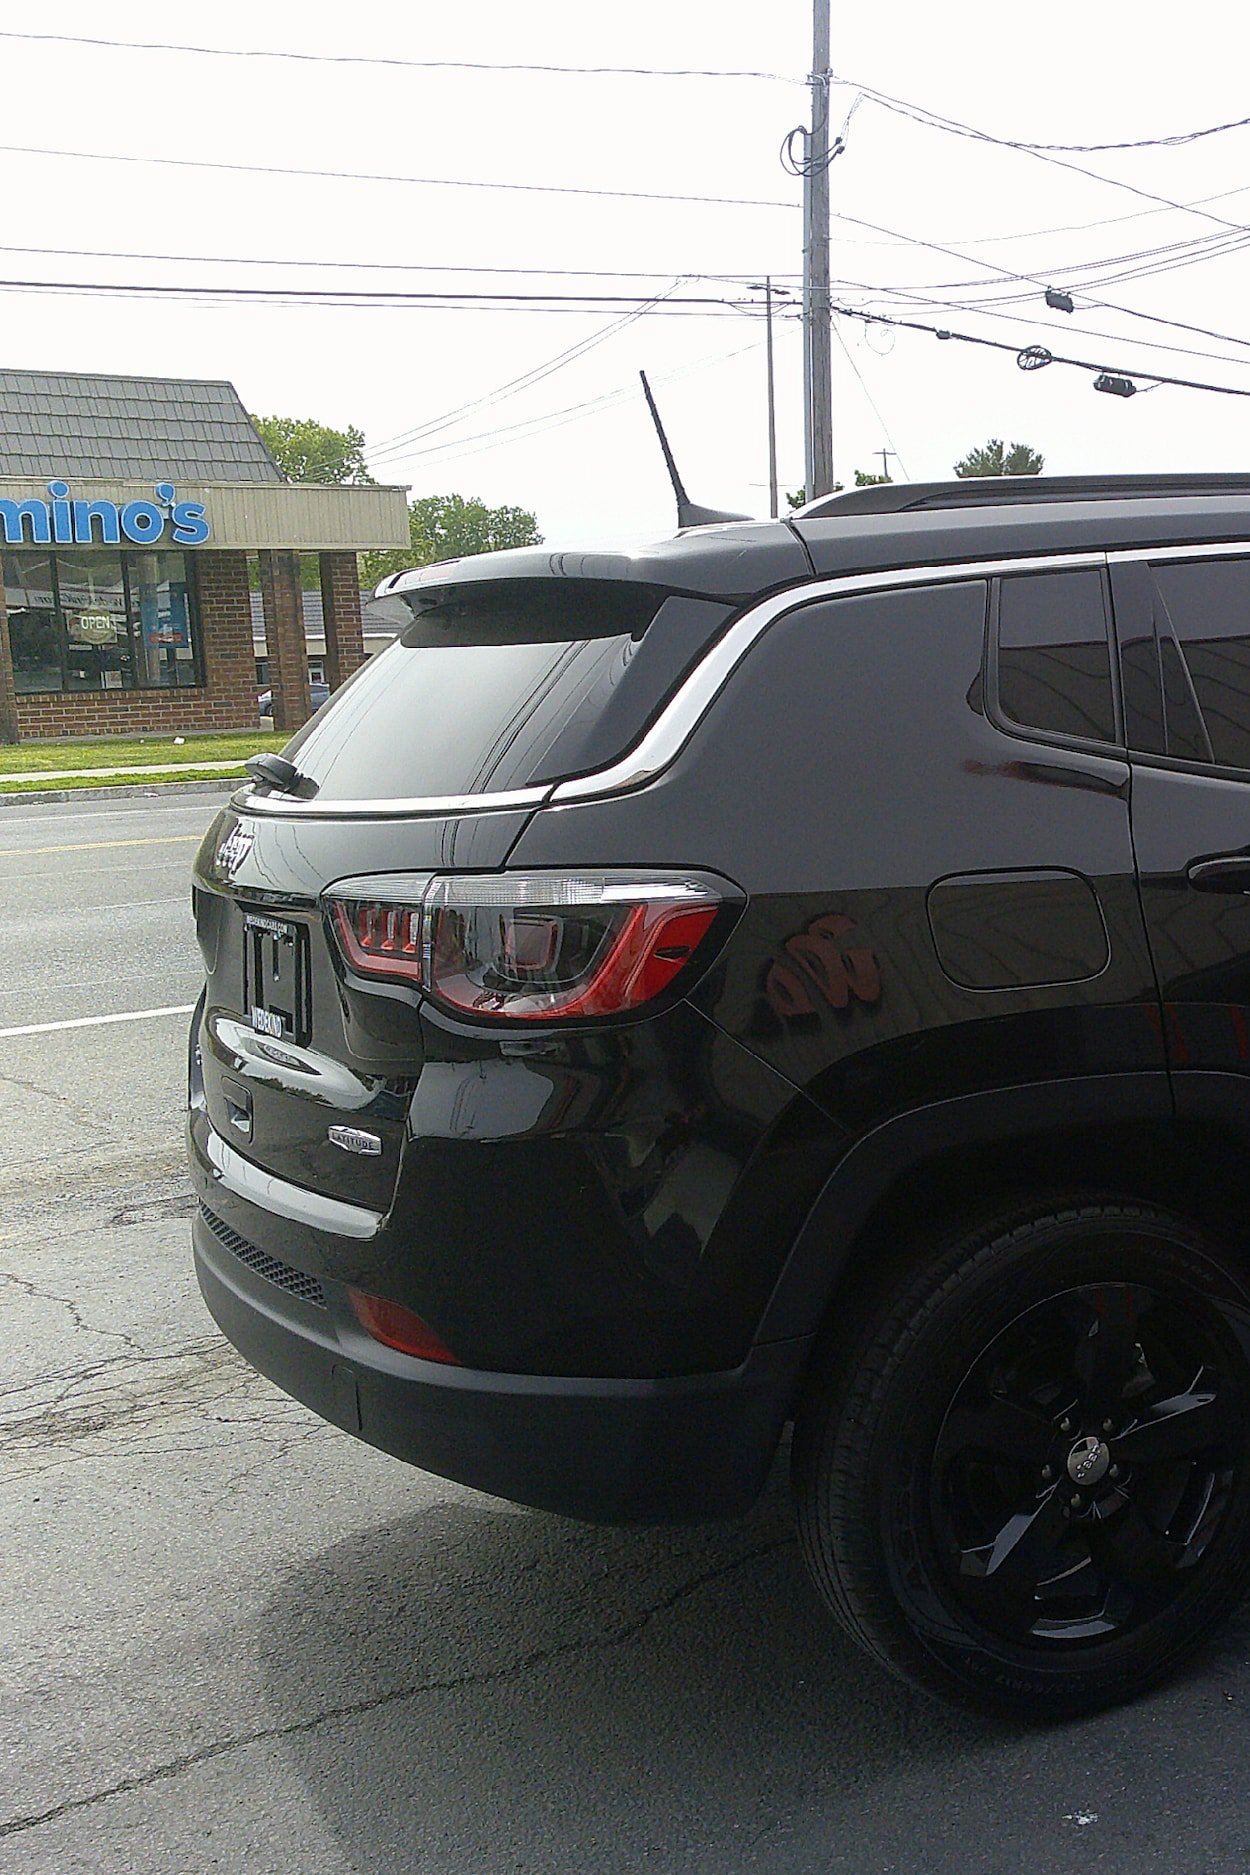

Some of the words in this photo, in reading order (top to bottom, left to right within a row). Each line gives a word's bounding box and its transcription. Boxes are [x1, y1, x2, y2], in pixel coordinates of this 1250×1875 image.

[81, 615, 111, 630] OPEN
[250, 1004, 283, 1039] WEDEKIND
[331, 1131, 374, 1150] LATITUDE
